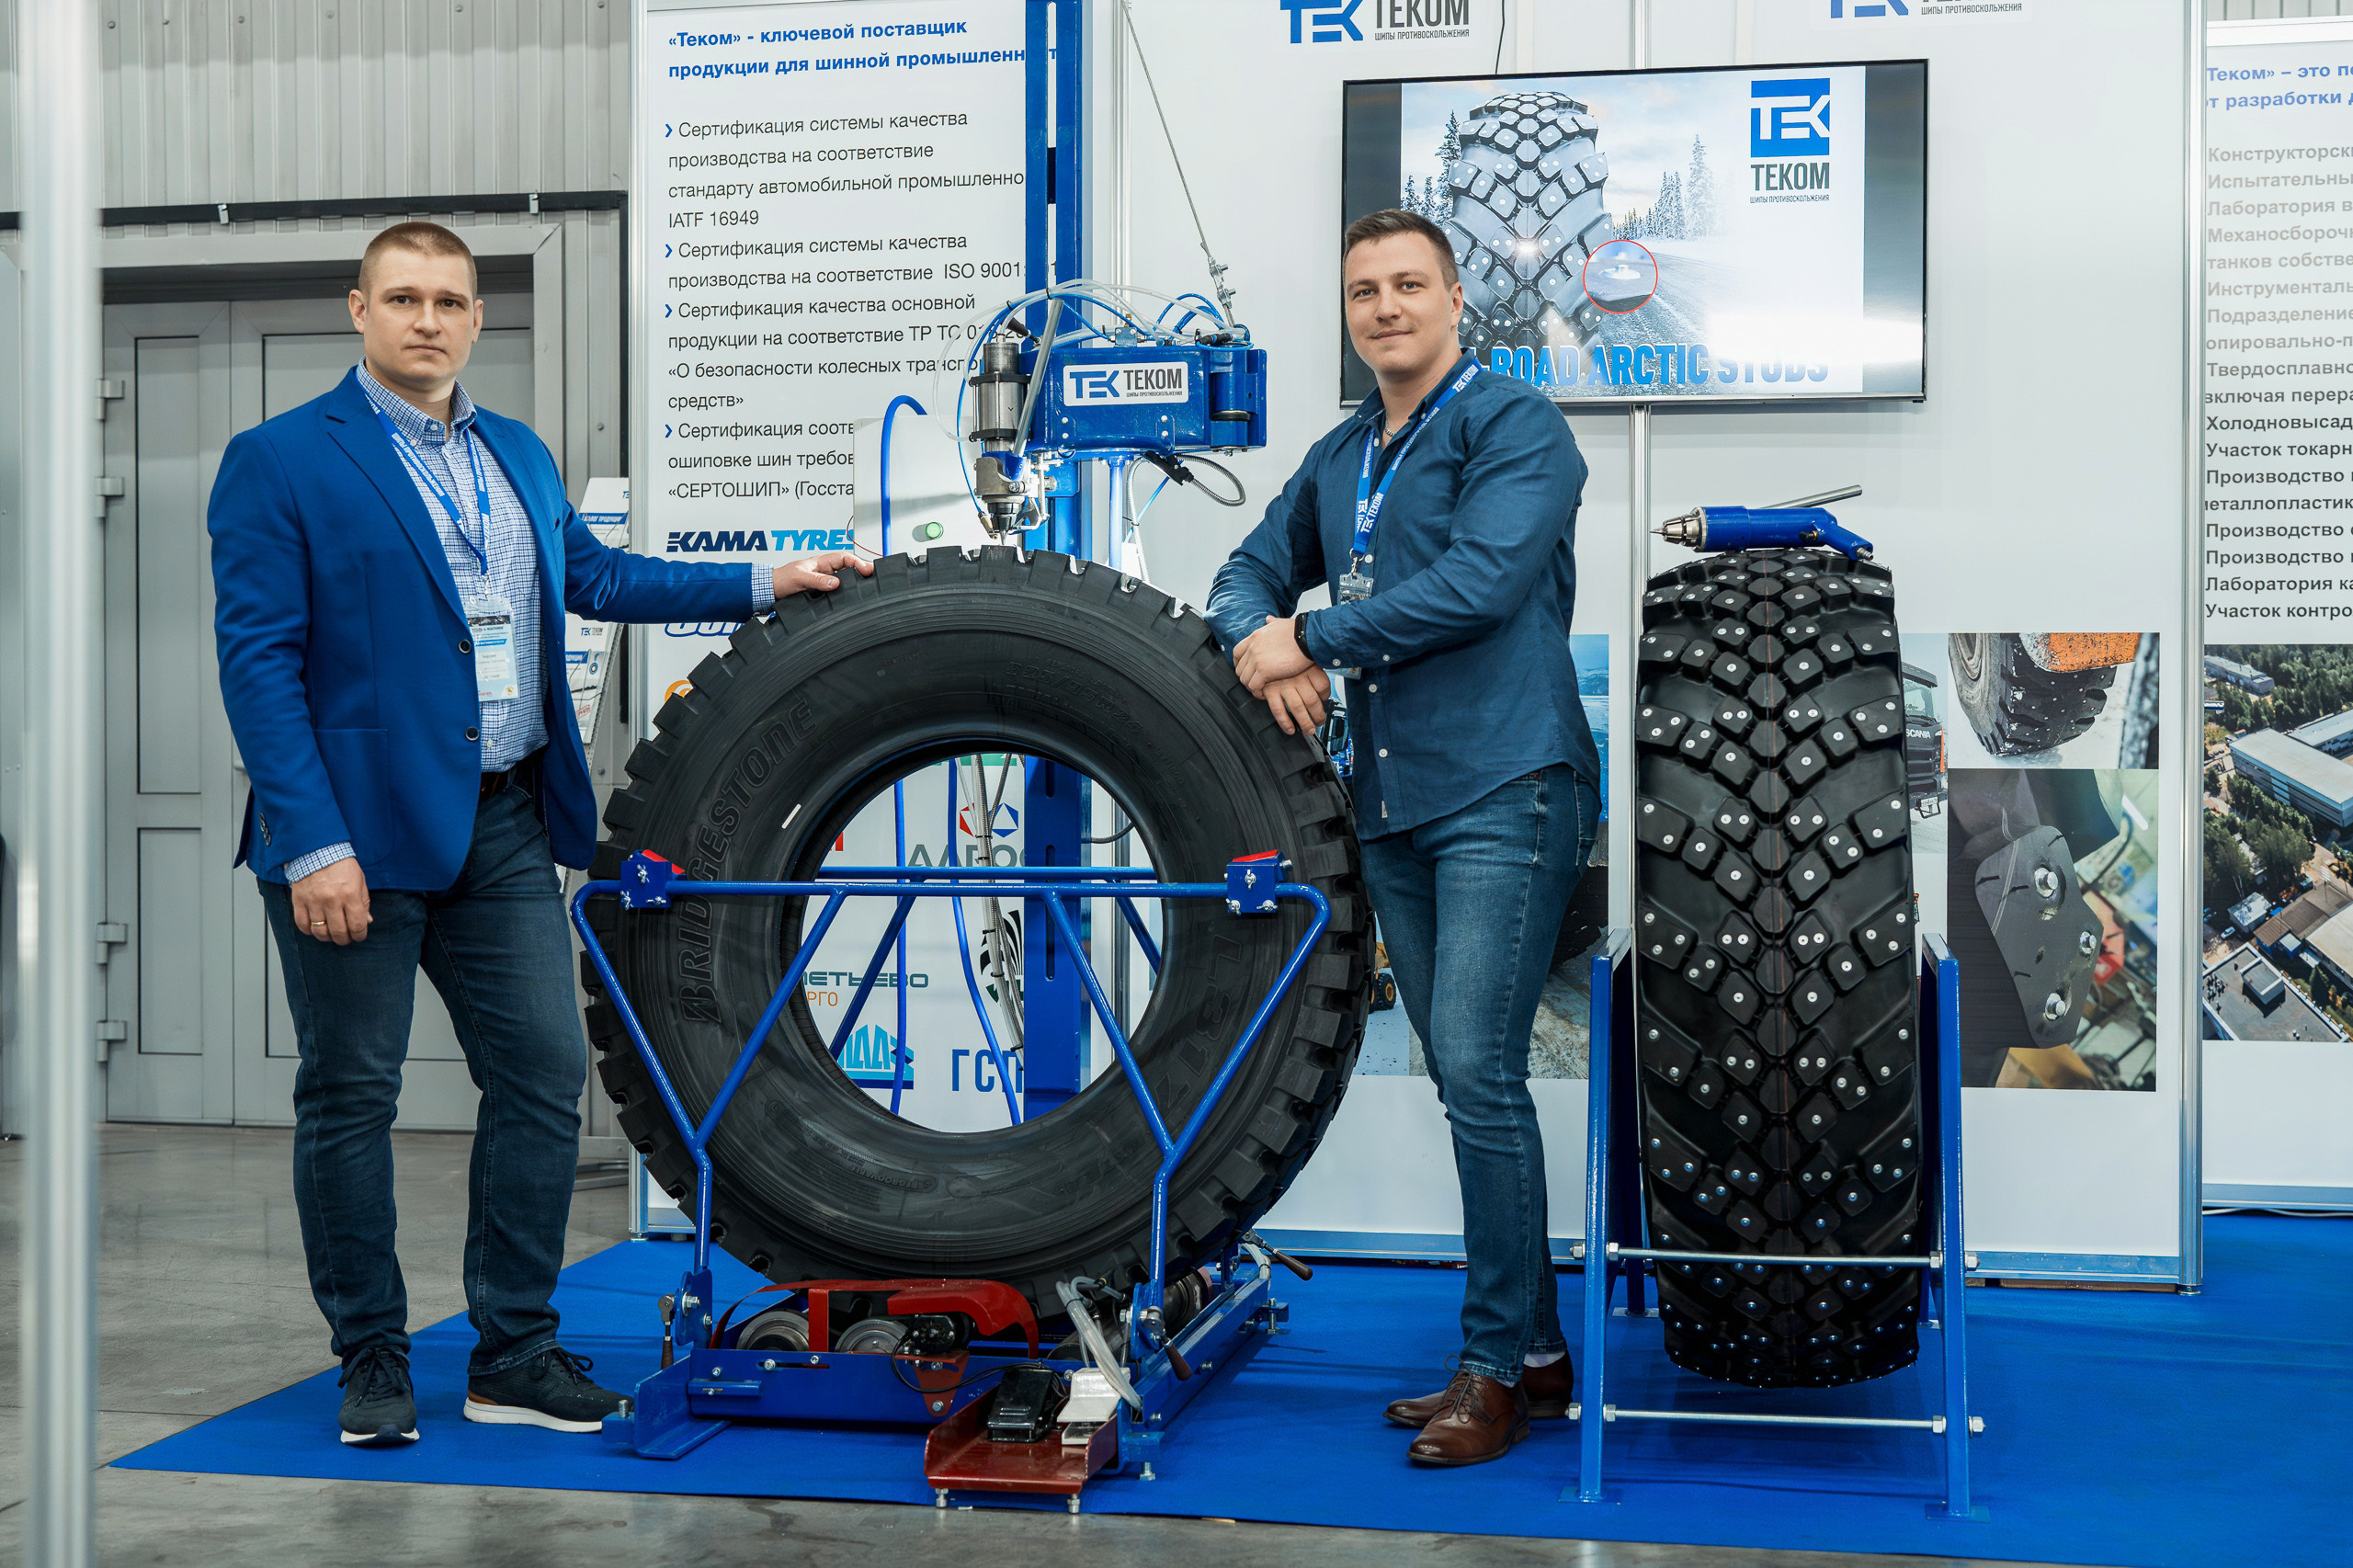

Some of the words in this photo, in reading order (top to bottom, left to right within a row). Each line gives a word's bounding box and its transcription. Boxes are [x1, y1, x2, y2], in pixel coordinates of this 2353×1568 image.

[1921, 6, 1943, 16] ШИПЫ
[1945, 3, 2022, 15] ПРОТИВОСКОЛЬЖЕНИЯ
[668, 31, 741, 48] «Теком»
[760, 23, 855, 43] ключевой
[861, 21, 968, 39] поставщик
[1374, 31, 1395, 41] ШИПЫ
[1397, 28, 1470, 40] ПРОТИВОСКОЛЬЖЕНИЯ
[668, 62, 769, 81] продукции
[775, 60, 809, 75] для
[815, 51, 890, 71] шинной
[895, 46, 1057, 70] промышленнт
[2297, 66, 2331, 78] это
[2225, 91, 2342, 111] разработки
[678, 119, 804, 141] Сертификация
[809, 117, 883, 131] системы
[889, 113, 968, 129] качества
[668, 151, 787, 172] производства
[792, 150, 813, 163] на
[817, 145, 934, 162] соответствие
[1750, 162, 1830, 191] ТЕКОМ
[668, 183, 755, 200] стандарту
[758, 174, 892, 195] автомобильной
[2207, 199, 2336, 219] Лаборатория
[669, 211, 704, 229] IATF
[710, 210, 759, 227] 16949
[678, 240, 803, 261] Сертификация
[809, 239, 883, 254] системы
[889, 236, 968, 251] качества
[668, 272, 787, 292] производства
[791, 271, 812, 284] на
[816, 267, 933, 283] соответствие
[944, 262, 975, 279] ISO
[678, 301, 803, 321] Сертификация
[809, 300, 887, 314] качества
[892, 293, 975, 312] основной
[668, 334, 757, 352] продукции
[763, 333, 783, 346] на
[788, 330, 904, 345] соответствие
[908, 325, 932, 342] ТР
[668, 362, 690, 379] «О
[695, 362, 813, 378] безопасности
[818, 360, 902, 374] колесных
[1491, 345, 1580, 387] ROAD
[1586, 343, 1710, 386] ARCTIC
[1123, 368, 1183, 391] ТЕКОМ
[668, 395, 745, 413] средств»
[678, 421, 803, 442] Сертификация
[2205, 442, 2282, 458] Участок
[668, 455, 752, 469] ошиповке
[756, 454, 791, 467] шин
[2206, 470, 2345, 488] Производство
[668, 481, 790, 499] «СЕРТОШИП»
[2204, 497, 2353, 512] еталлопластик
[666, 530, 768, 553] KAMA
[2206, 523, 2345, 541] Производство
[2206, 550, 2345, 568] Производство
[2205, 576, 2333, 595] Лаборатория
[2205, 603, 2281, 619] Участок
[1905, 728, 1931, 739] SCANIA
[678, 699, 818, 1024] BRIDGESTONE
